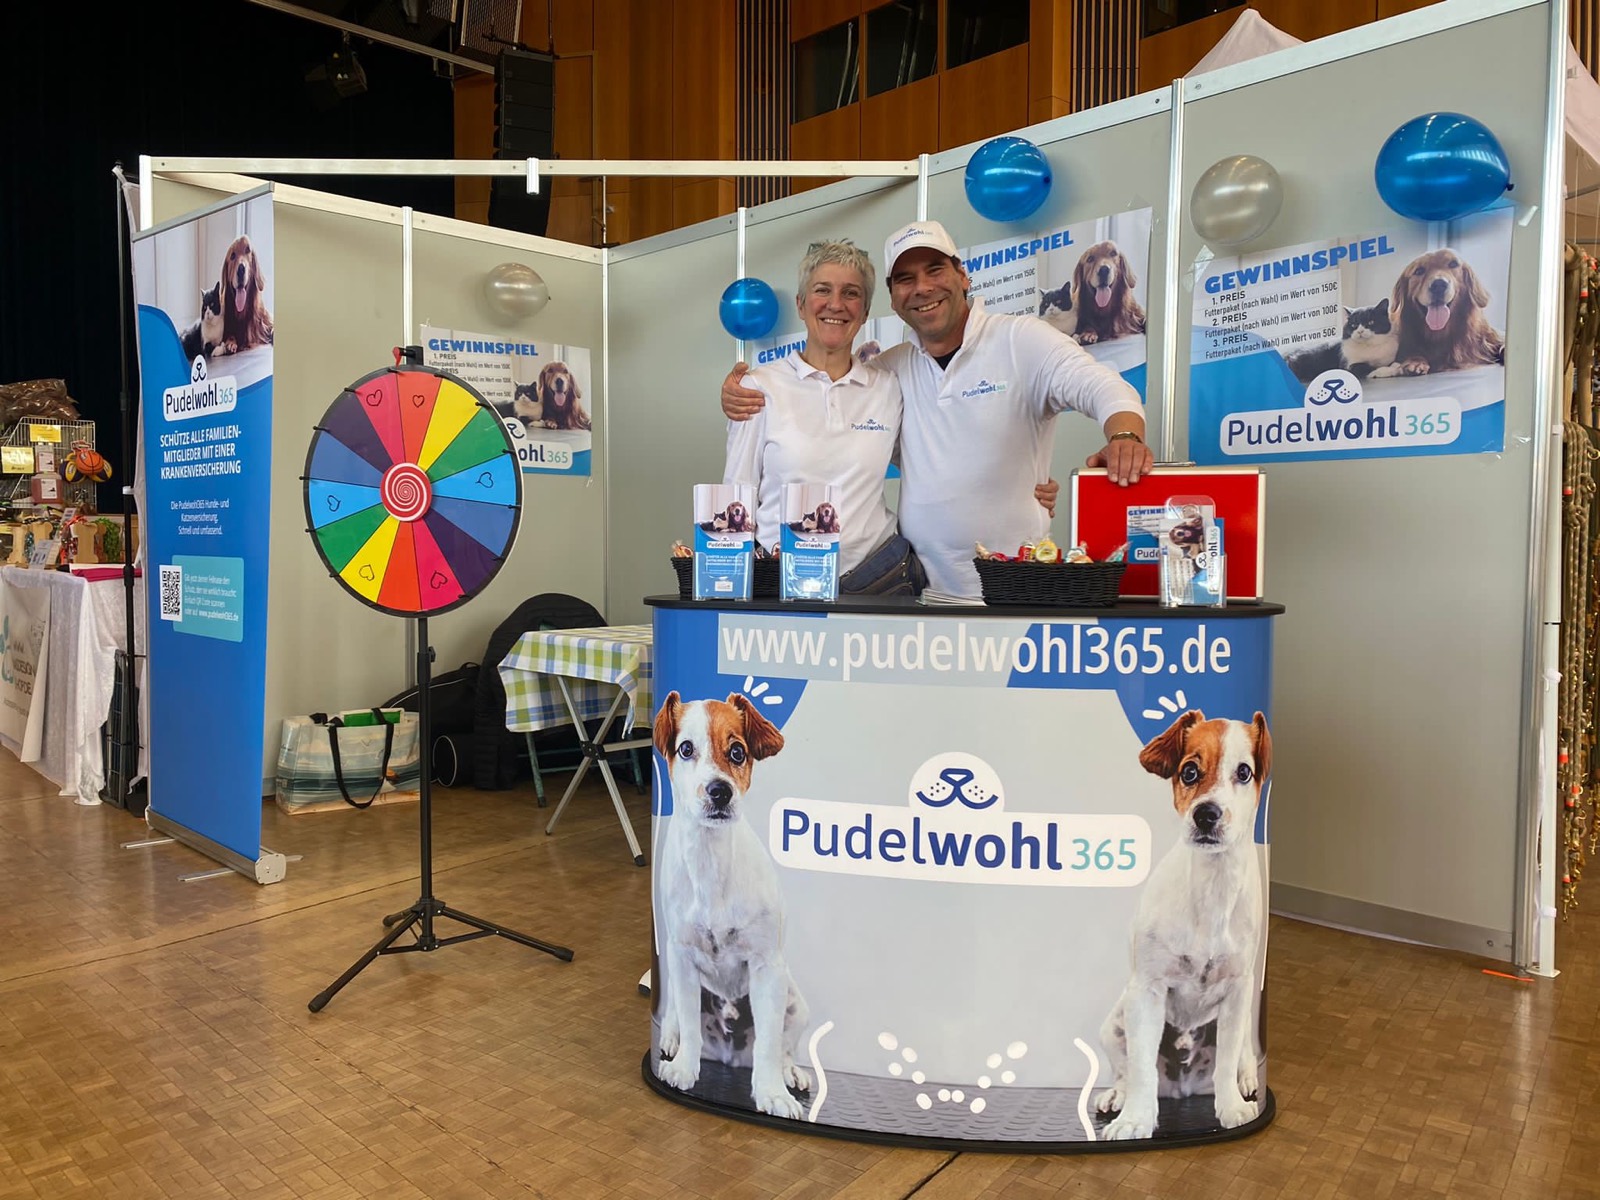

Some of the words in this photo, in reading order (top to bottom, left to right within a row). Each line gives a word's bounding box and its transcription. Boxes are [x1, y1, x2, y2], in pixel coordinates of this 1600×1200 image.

[1024, 268, 1035, 277] 150€
[1204, 235, 1394, 294] GEWINNSPIEL
[1205, 303, 1240, 317] Futterpaket
[1242, 299, 1259, 310] (nach
[1260, 294, 1278, 305] Wahl)
[1290, 289, 1305, 299] Wert
[1307, 287, 1319, 295] von
[1322, 282, 1337, 292] 150€
[1220, 290, 1246, 303] PREIS
[1205, 325, 1240, 338] Futterpaket
[1242, 320, 1259, 332] (nach
[1261, 316, 1279, 327] Wahl)
[1291, 312, 1306, 321] Wert
[1308, 310, 1320, 318] von
[1322, 304, 1338, 315] 100€
[1222, 312, 1247, 324] PREIS
[428, 339, 538, 356] GEWINNSPIEL
[1206, 346, 1241, 359] Futterpaket
[1243, 342, 1260, 353] (nach
[1262, 338, 1280, 349] Wahl)
[1291, 334, 1306, 343] Wert
[1308, 332, 1321, 340] von
[1323, 328, 1336, 338] 50€
[1223, 333, 1248, 345] PREIS
[166, 383, 218, 414] Pudelwohl
[962, 384, 996, 397] Pudelwohl
[160, 430, 189, 447] SCHÜTZE
[191, 430, 204, 443] ALLE
[206, 425, 242, 441] FAMILIEN-
[1228, 406, 1398, 446] Pudelwohl
[1404, 412, 1450, 436] 365
[164, 447, 201, 463] MITGLIEDER
[202, 446, 213, 459] MIT
[215, 443, 235, 458] EINER
[547, 451, 568, 463] 365
[161, 460, 241, 479] KRANKENVERSICHERUNG
[722, 620, 1231, 682] www.pudelwohl365.de
[783, 808, 1062, 870] Pudelwohl
[1070, 838, 1136, 870] 365
